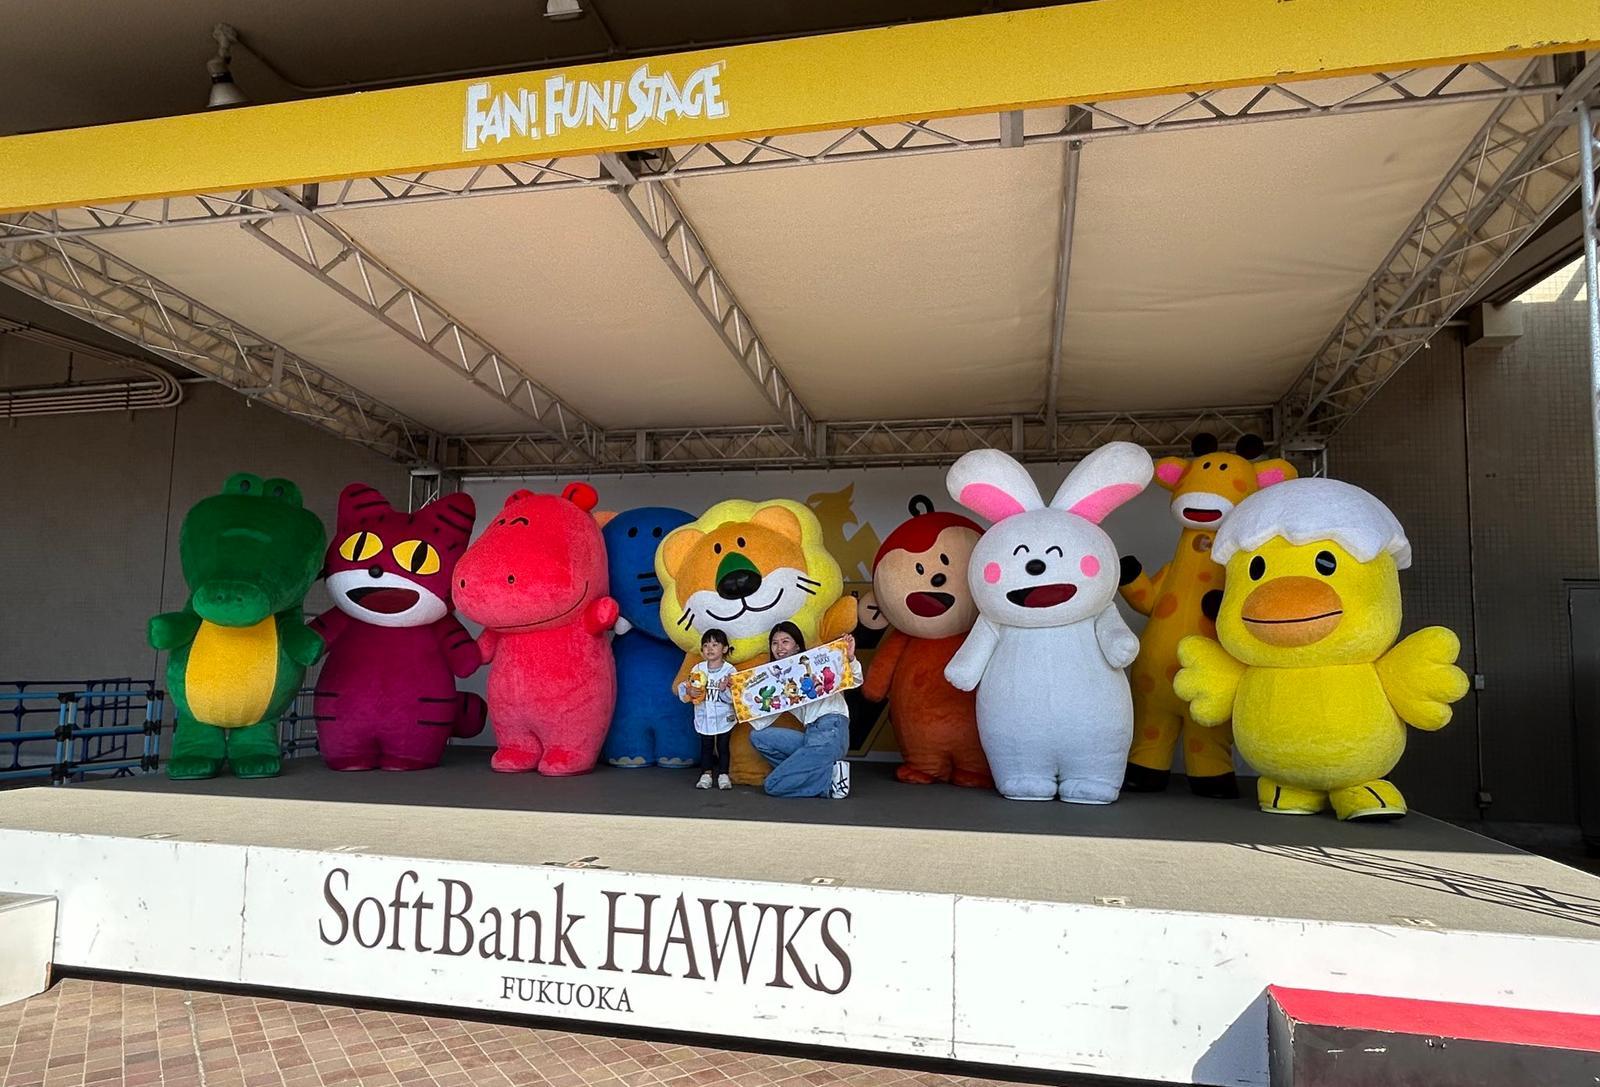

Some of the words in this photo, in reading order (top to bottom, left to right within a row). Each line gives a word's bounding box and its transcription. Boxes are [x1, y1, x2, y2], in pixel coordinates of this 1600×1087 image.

[462, 81, 540, 151] FAN!
[546, 75, 625, 136] FUN!
[626, 60, 729, 134] STAGE
[318, 867, 587, 970] SoftBank
[597, 889, 853, 995] HAWKS
[500, 976, 634, 1013] FUKUOKA
